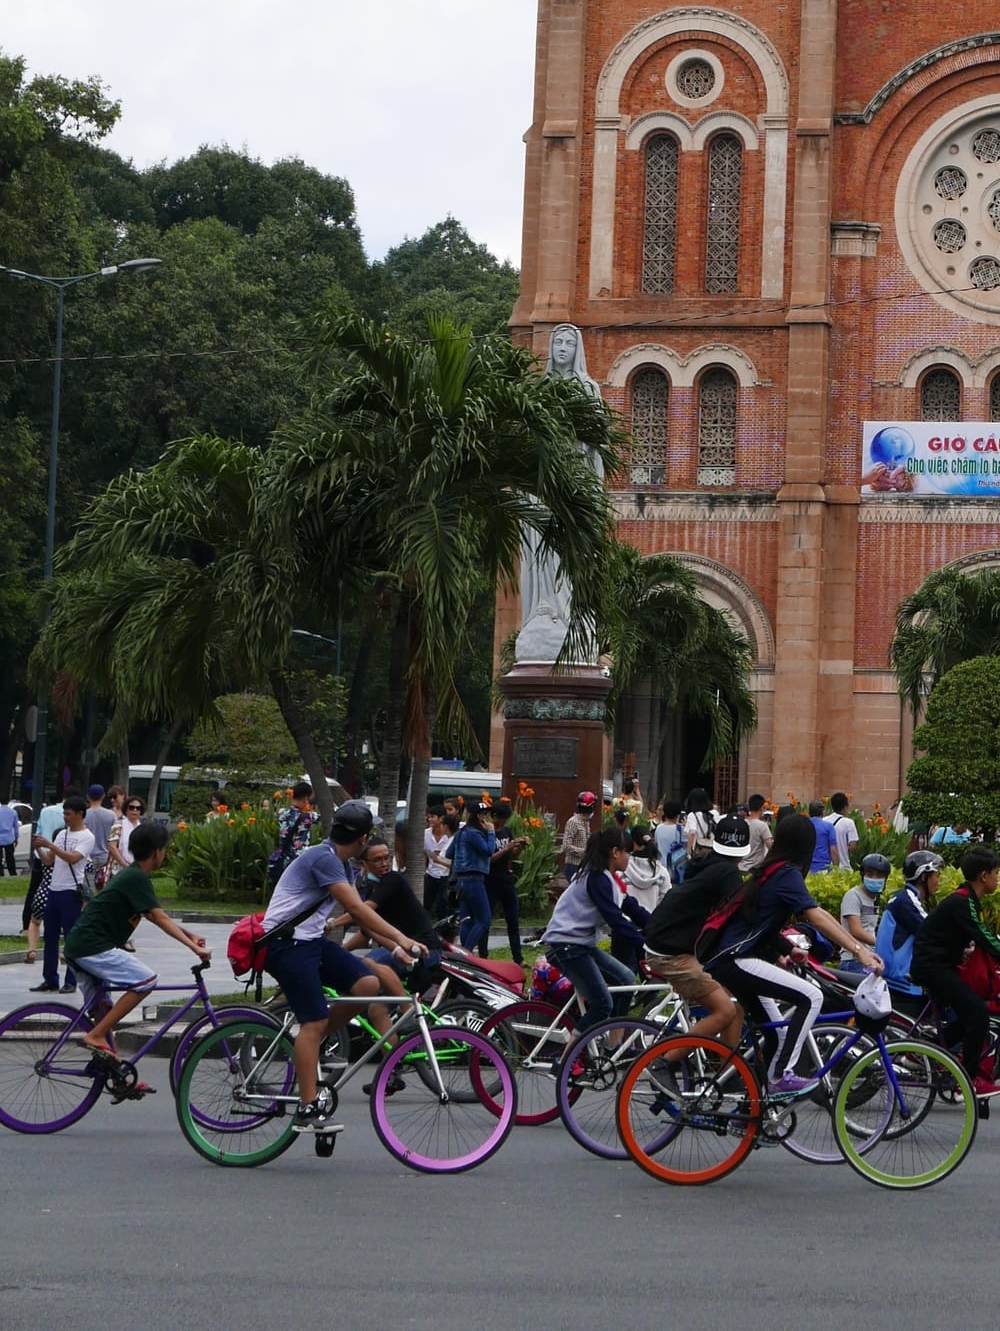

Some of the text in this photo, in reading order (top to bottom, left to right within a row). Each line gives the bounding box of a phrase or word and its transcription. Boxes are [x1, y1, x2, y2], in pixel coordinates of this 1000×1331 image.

[927, 433, 967, 452] GIỜ
[907, 457, 925, 474] Cho
[928, 456, 948, 477] việc
[980, 457, 990, 475] lo
